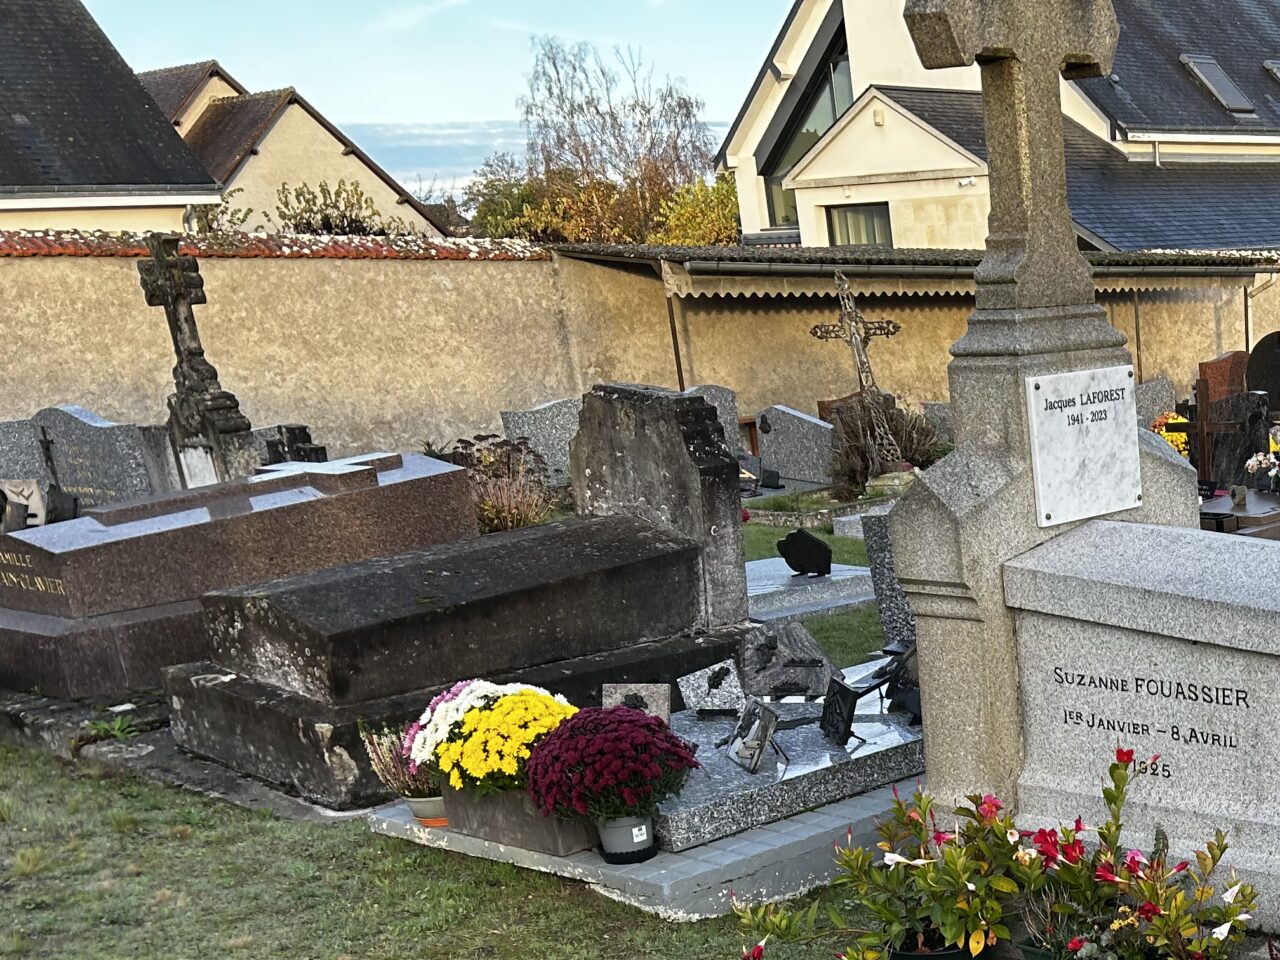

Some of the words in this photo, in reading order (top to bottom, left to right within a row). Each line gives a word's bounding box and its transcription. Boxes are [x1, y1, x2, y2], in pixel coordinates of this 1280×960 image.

[1044, 397, 1076, 412] Jacques
[1080, 388, 1125, 406] LAFOREST
[1067, 413, 1084, 426] 1941
[1090, 409, 1107, 422] 2023
[1054, 667, 1129, 692] SUZANNE
[1135, 677, 1250, 708] FOUASSIER
[1087, 713, 1150, 735] JANVIER
[1171, 726, 1180, 741] 8
[1188, 728, 1237, 749] AVRIL
[1132, 759, 1171, 779] 1925
